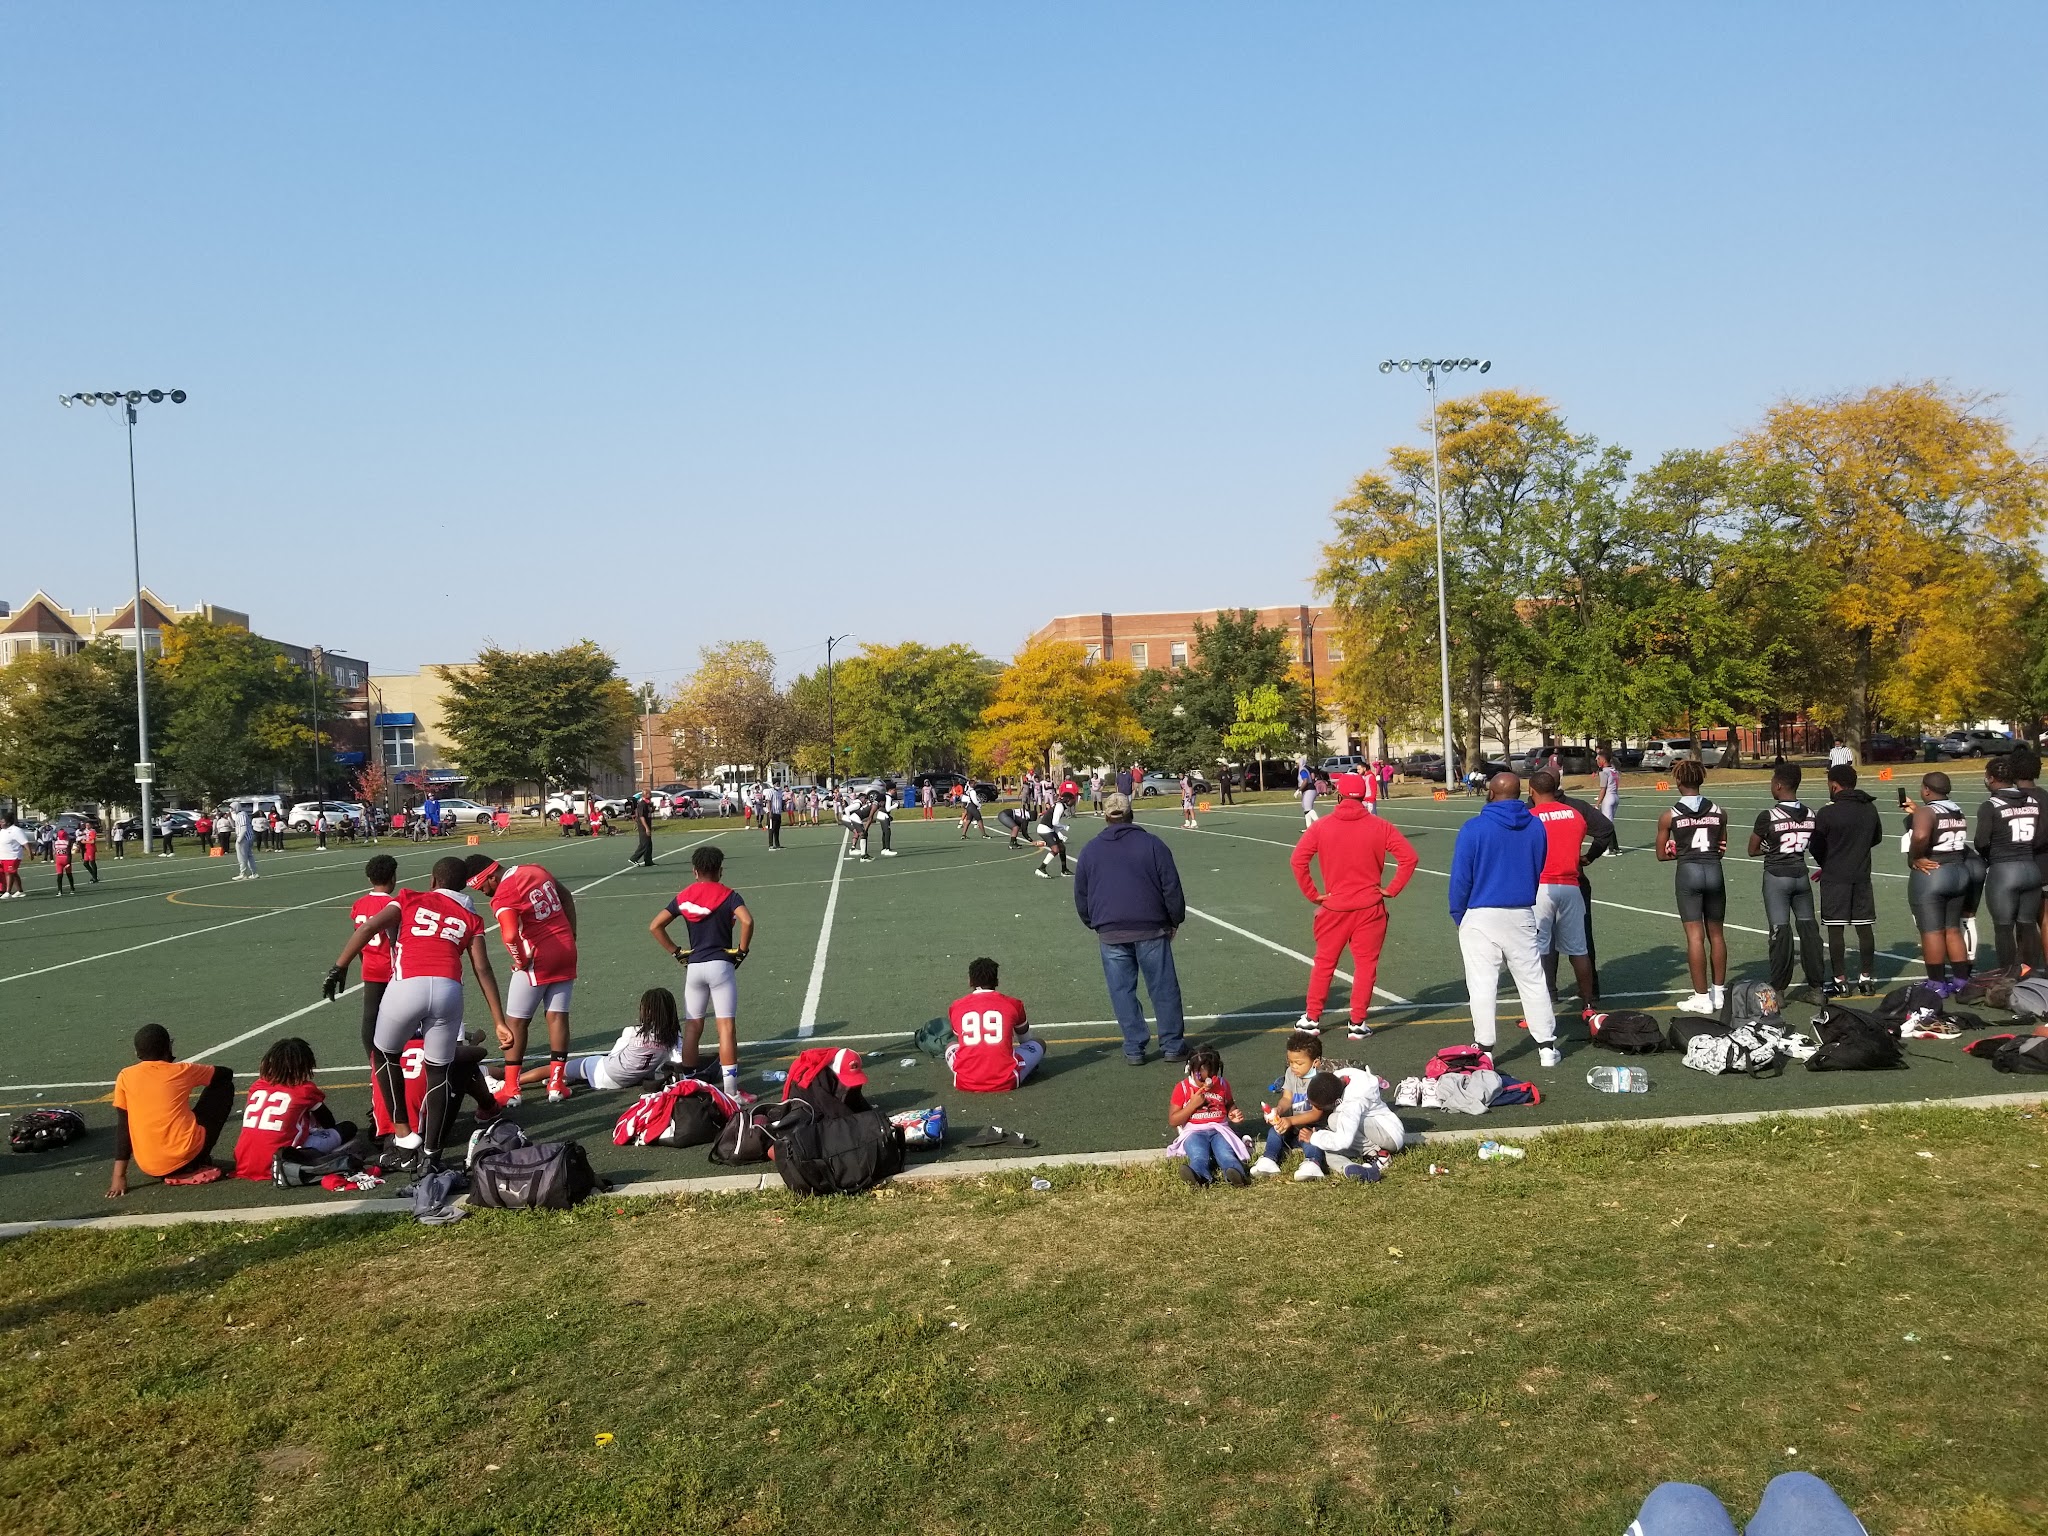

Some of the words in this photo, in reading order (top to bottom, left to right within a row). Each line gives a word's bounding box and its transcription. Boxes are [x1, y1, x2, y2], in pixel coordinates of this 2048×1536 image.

[1549, 809, 1575, 820] BOUND
[1676, 817, 1689, 828] RED
[1690, 816, 1720, 826] MACHINE
[2001, 808, 2013, 818] RED
[1774, 821, 1789, 832] RED
[1938, 819, 1949, 829] RED
[2008, 817, 2035, 842] 15
[468, 836, 478, 845] 40
[1691, 827, 1710, 852] 4
[1780, 832, 1811, 853] 25
[529, 880, 562, 921] 60
[411, 907, 467, 945] 52
[961, 1010, 1003, 1046] 99
[243, 1089, 292, 1132] 22
